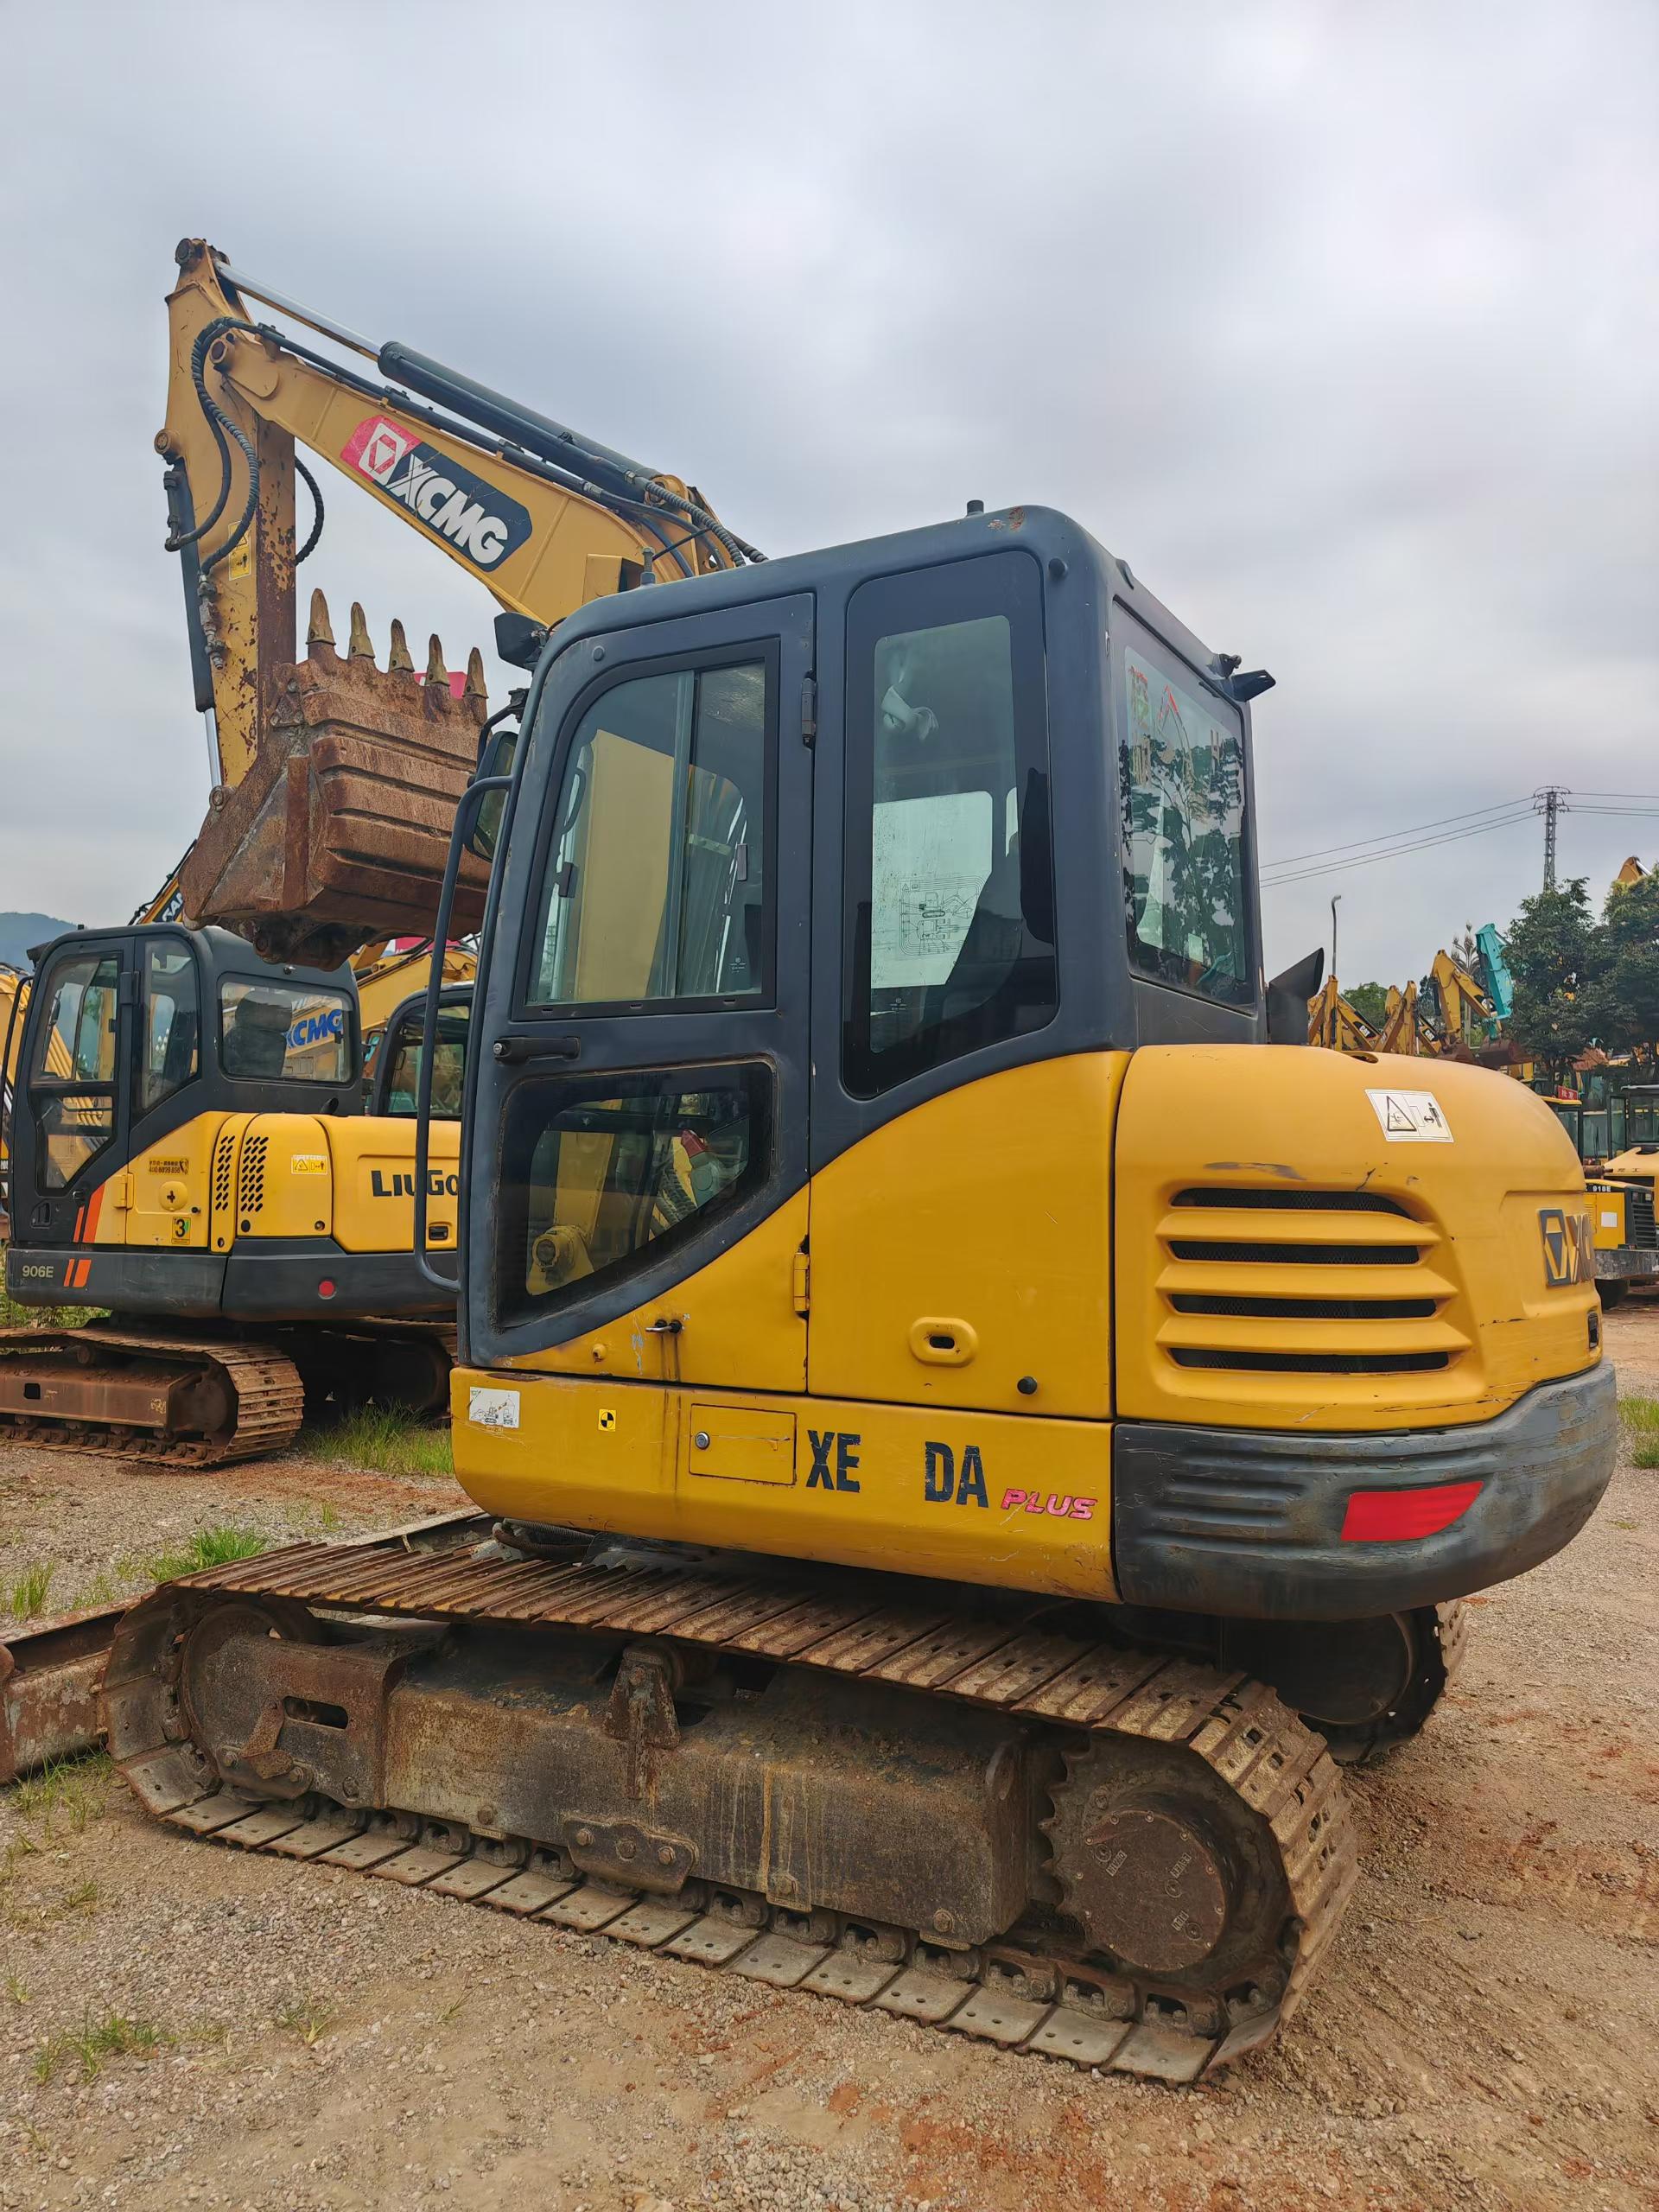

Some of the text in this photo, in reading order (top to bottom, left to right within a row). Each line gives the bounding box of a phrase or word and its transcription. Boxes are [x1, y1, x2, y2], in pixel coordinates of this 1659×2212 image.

[386, 454, 508, 563] XCMG
[22, 1265, 54, 1278] 906E
[805, 1429, 989, 1508] XE DA
[1001, 1488, 1097, 1520] PLUS
